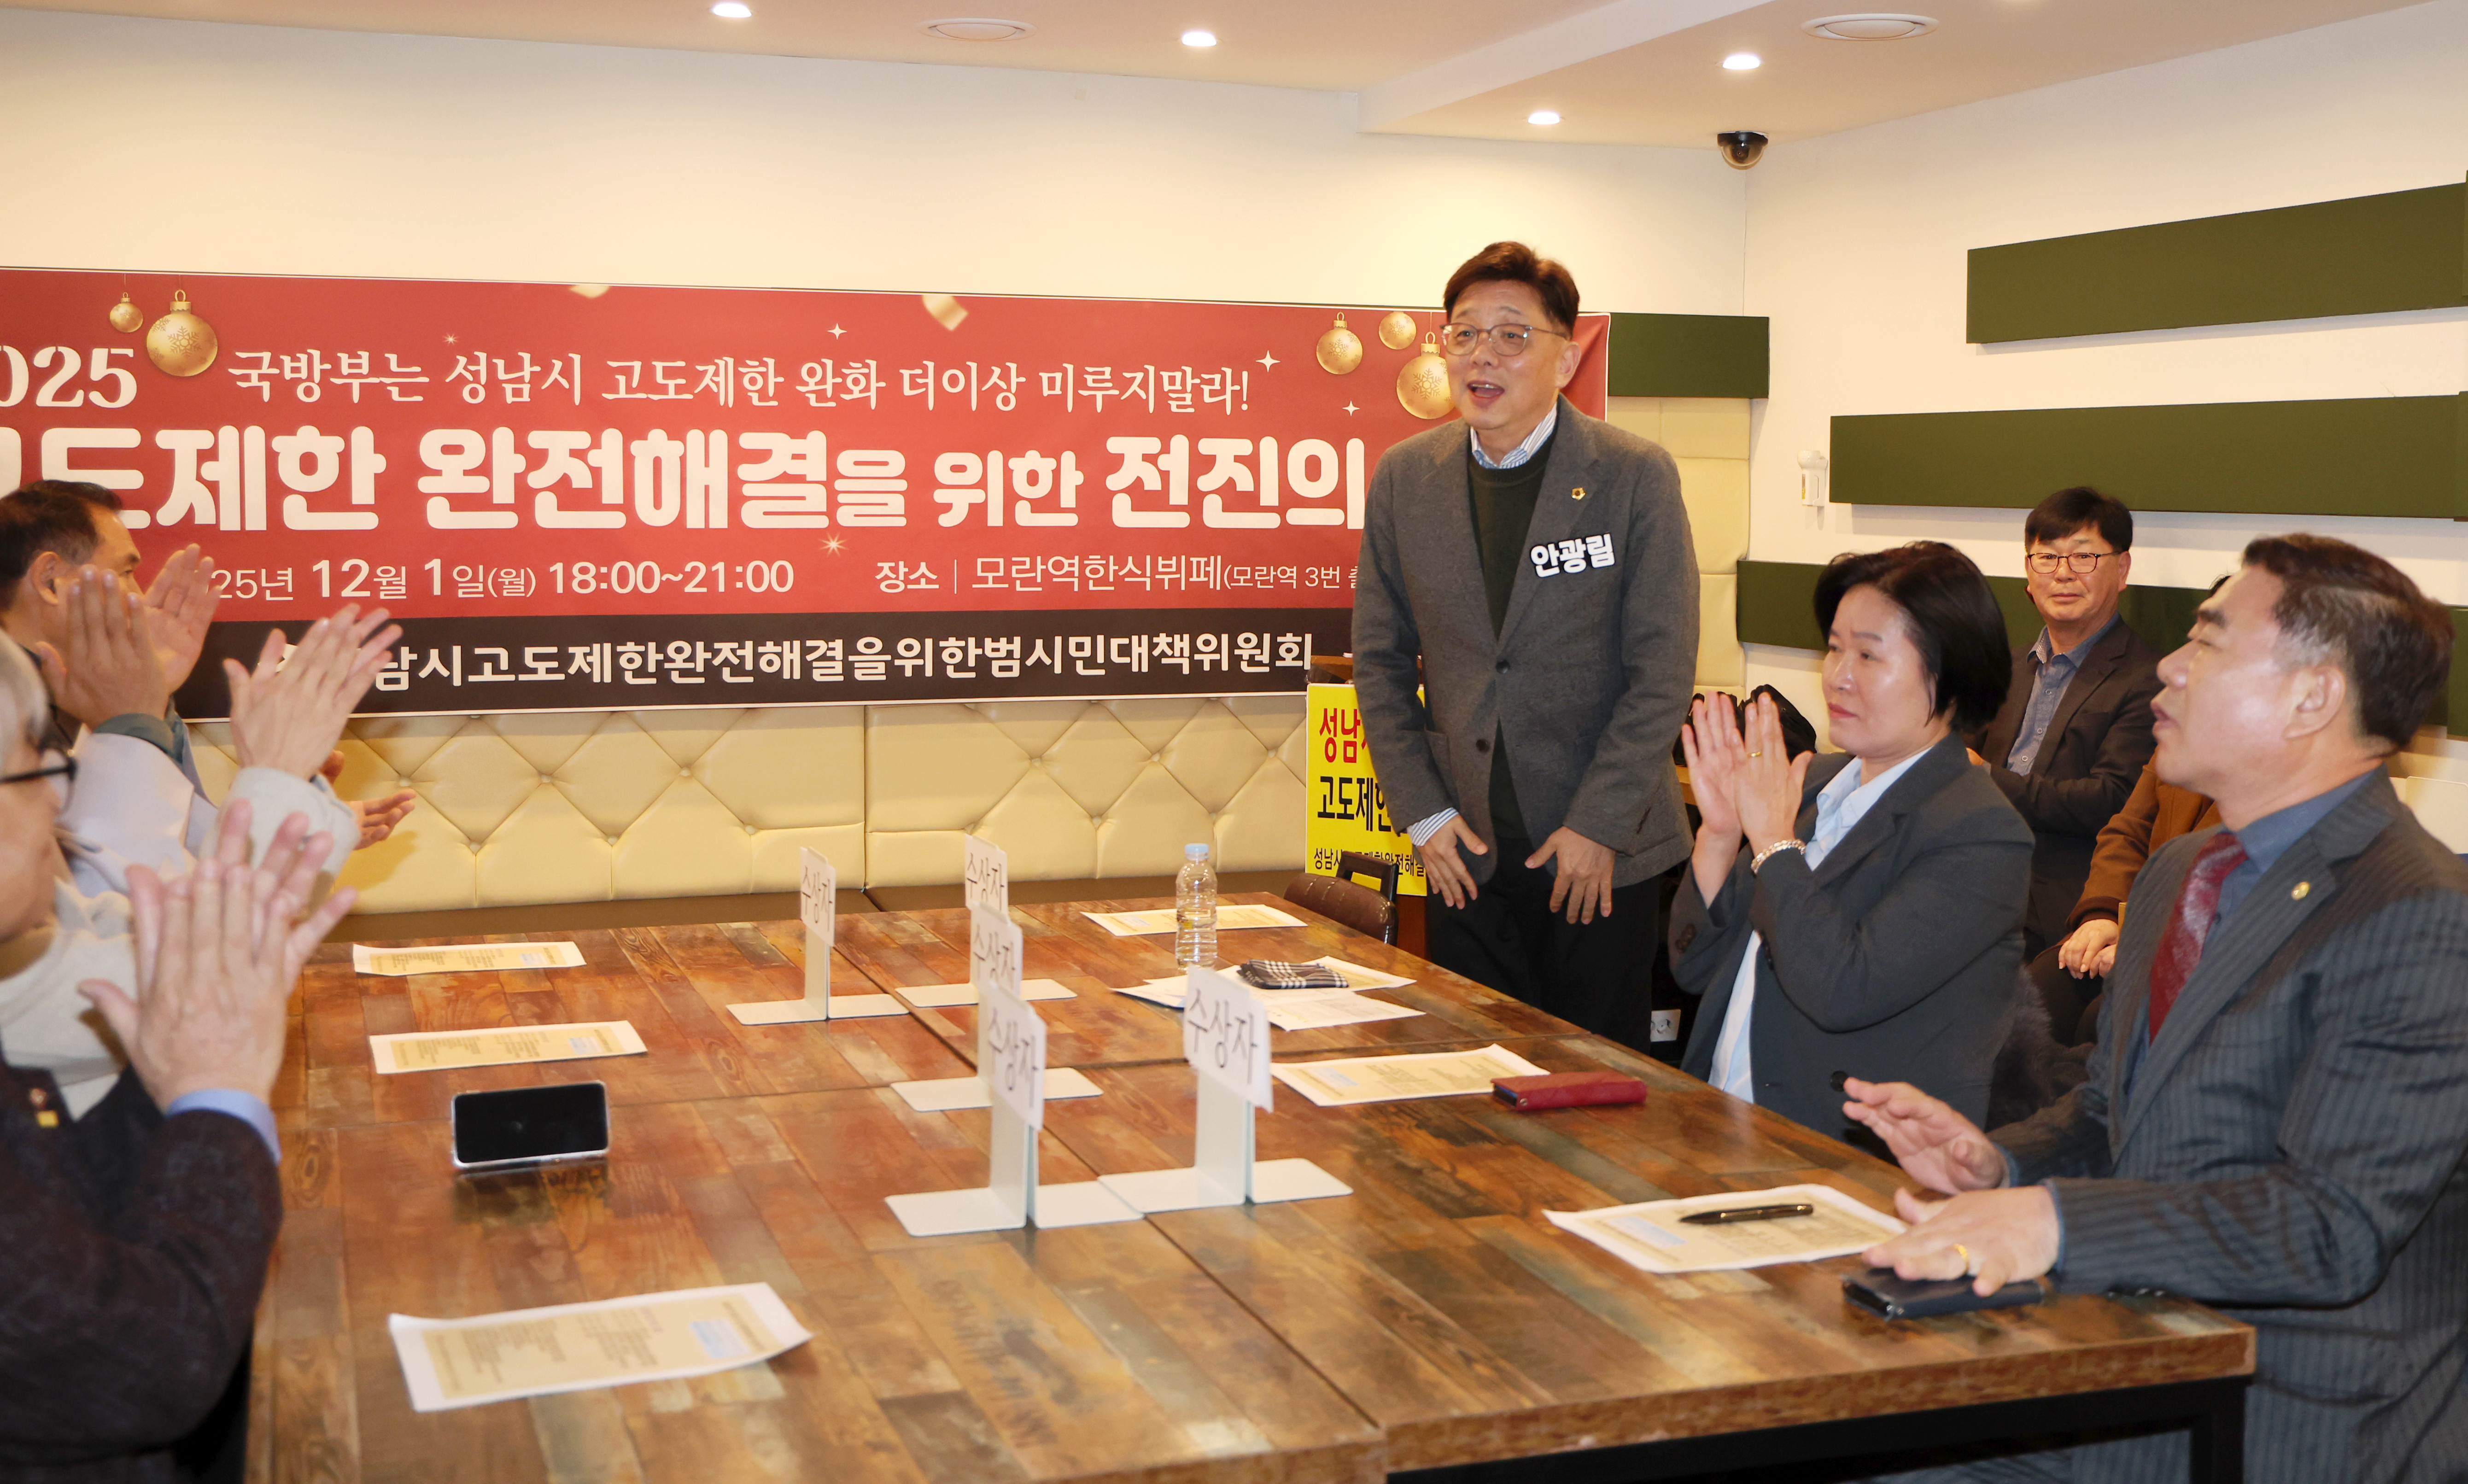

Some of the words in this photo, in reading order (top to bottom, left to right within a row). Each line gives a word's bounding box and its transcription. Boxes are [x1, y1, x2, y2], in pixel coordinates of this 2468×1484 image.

[227, 348, 430, 404] 국방부는
[444, 351, 582, 406] 성남시
[601, 356, 785, 409] 고도제한
[795, 358, 887, 410] 완화
[899, 359, 1027, 412] 더이상
[1038, 362, 1249, 416] 미루지말라!
[417, 427, 908, 530] 완전해결을
[933, 450, 1084, 528] 위한
[1105, 434, 1365, 530] 전진의
[205, 567, 294, 601] 25년
[312, 558, 408, 600] 12월
[549, 559, 795, 595] 18:00~21:00
[874, 561, 940, 594] 장소
[971, 554, 1297, 592] 모란역한식뷔페(모란역
[1304, 566, 1340, 589] 3번
[1530, 533, 1616, 578] 안광림
[357, 631, 1313, 692] 남시고도제한완전해결을위한범시민대책위원회
[1319, 707, 1367, 764] 성남
[801, 865, 833, 932] 수상자
[966, 852, 1005, 911] 수상자
[973, 923, 1016, 991] 수상자
[988, 1006, 1040, 1108] 수상자
[1187, 987, 1259, 1085] 수상자
